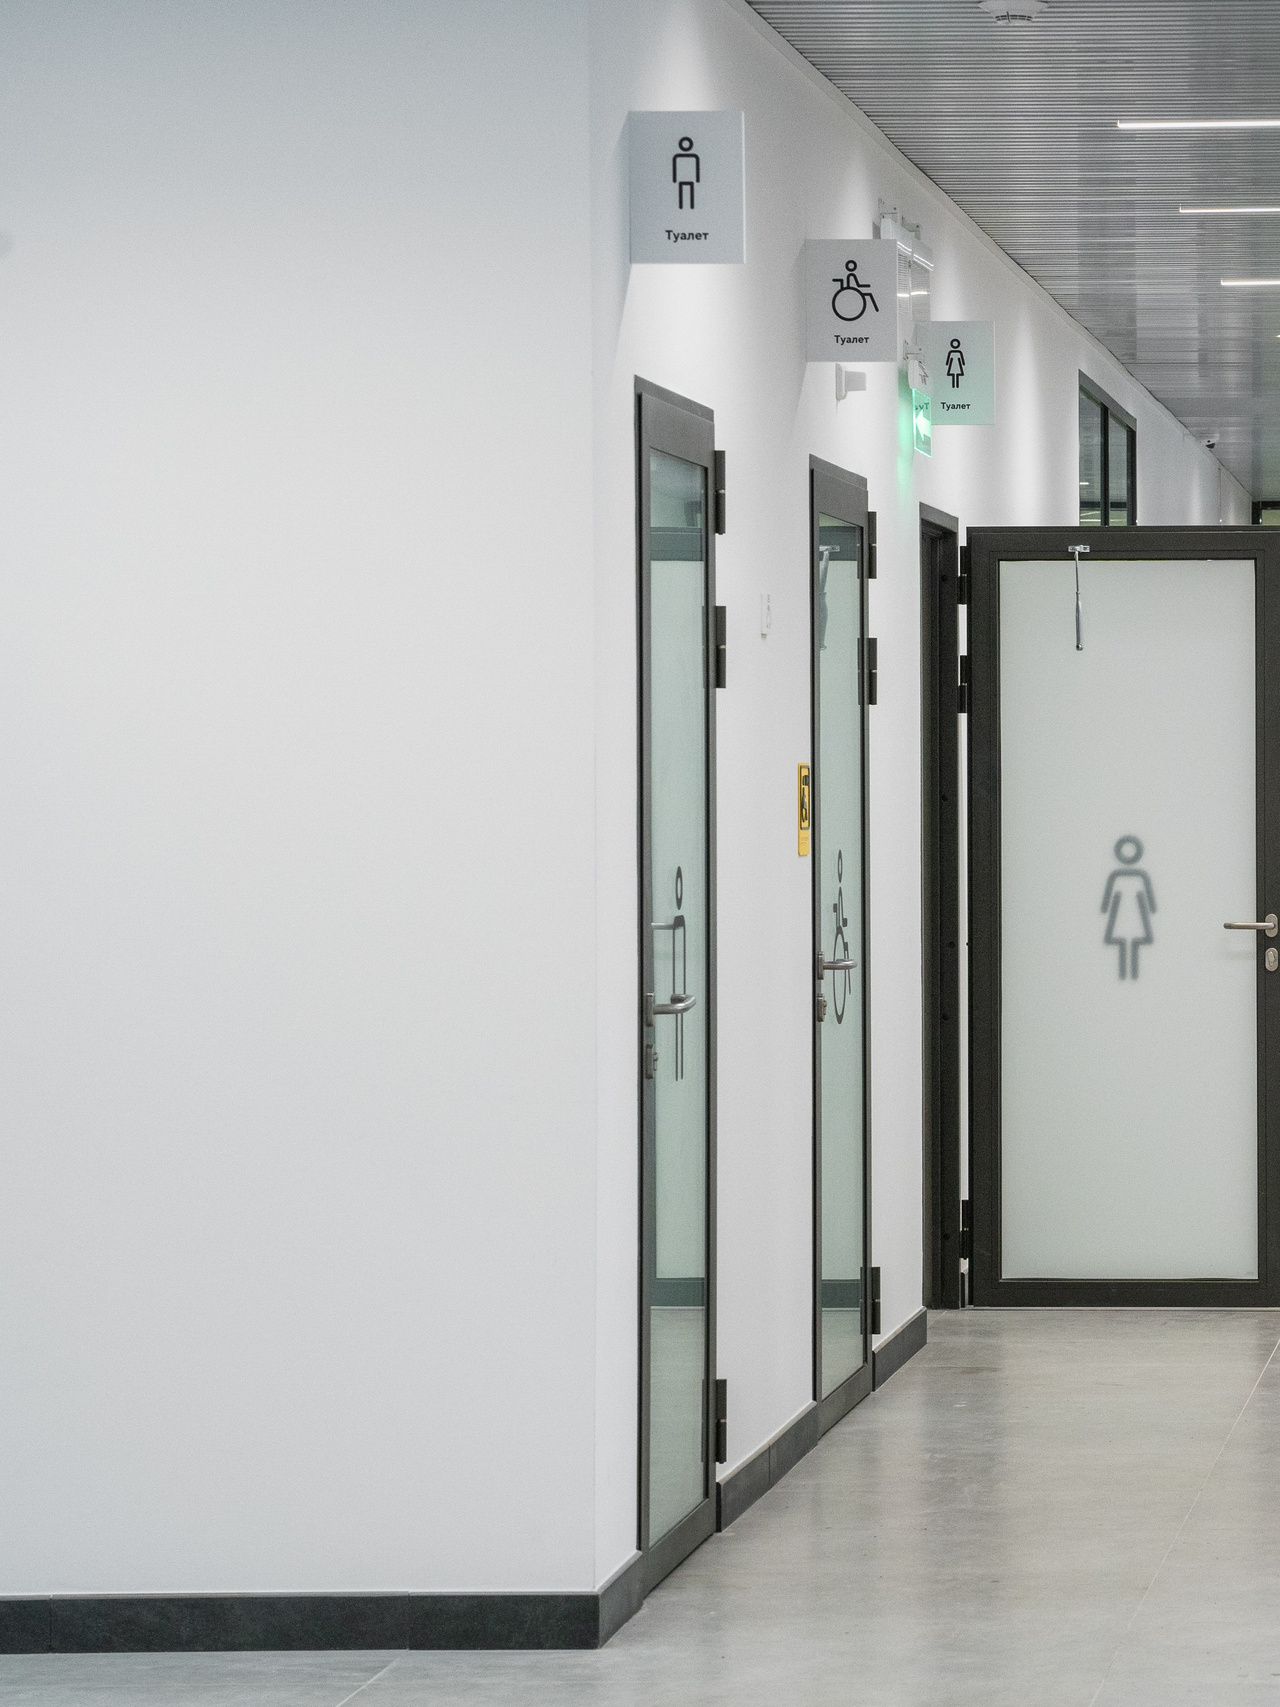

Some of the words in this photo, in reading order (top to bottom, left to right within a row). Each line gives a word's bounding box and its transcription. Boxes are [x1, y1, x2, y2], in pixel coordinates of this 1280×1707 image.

[665, 229, 709, 243] Туалет
[834, 334, 869, 346] Туалет
[941, 401, 971, 411] Туалет
